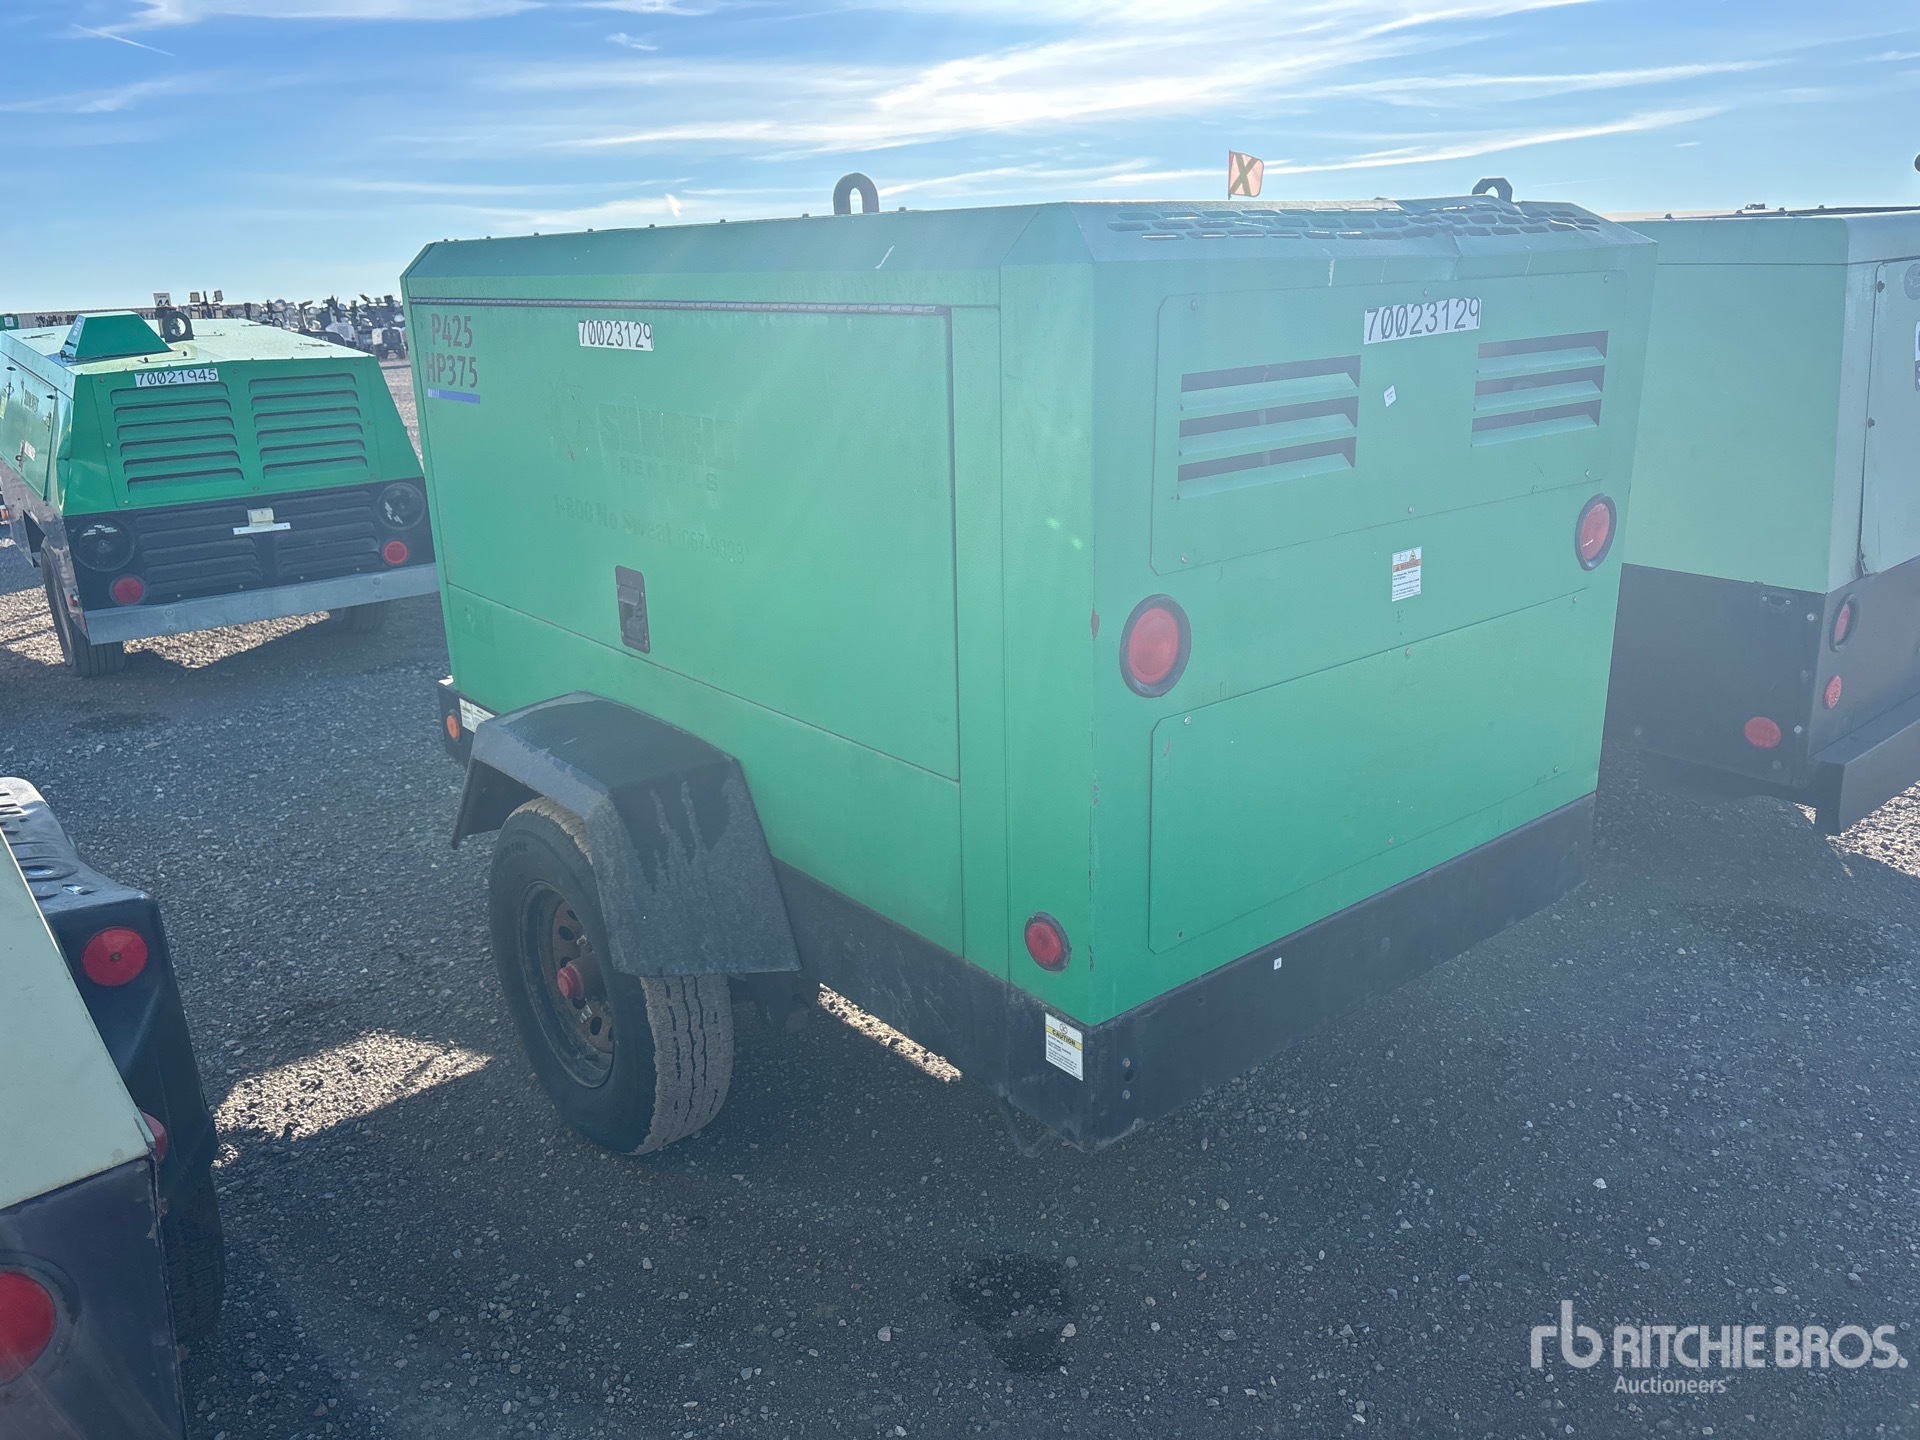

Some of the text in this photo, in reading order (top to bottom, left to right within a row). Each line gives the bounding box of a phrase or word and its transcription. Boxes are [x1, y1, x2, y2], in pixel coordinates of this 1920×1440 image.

[431, 313, 473, 349] P425
[579, 320, 653, 349] 70023129
[1366, 296, 1480, 341] 70023129
[136, 368, 217, 385] 70021945
[425, 351, 478, 388] HP375
[1052, 1029, 1076, 1047] CAUTION
